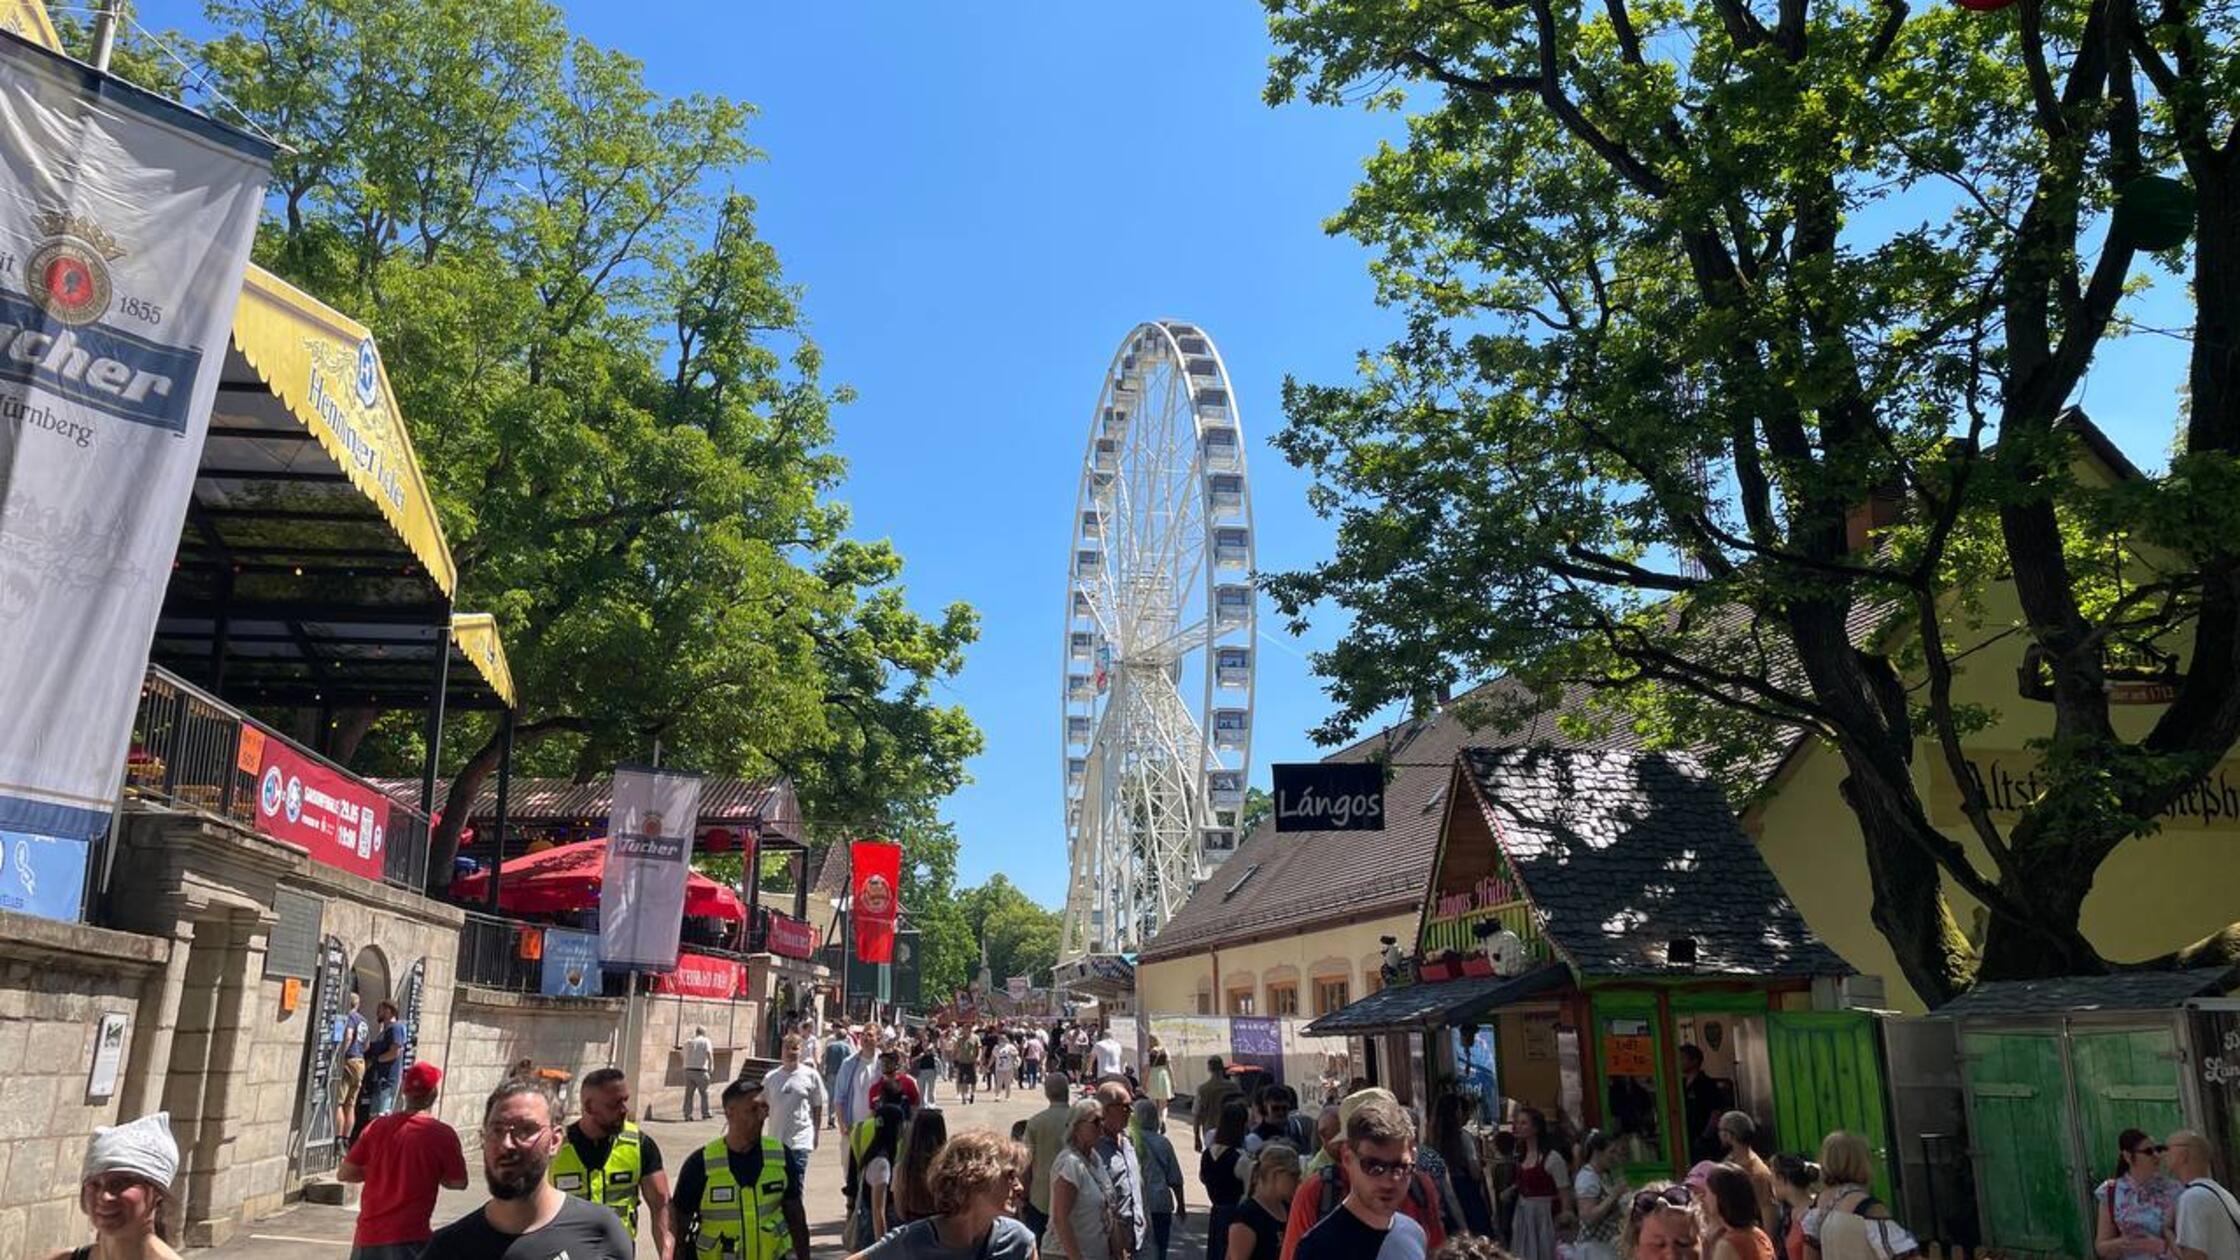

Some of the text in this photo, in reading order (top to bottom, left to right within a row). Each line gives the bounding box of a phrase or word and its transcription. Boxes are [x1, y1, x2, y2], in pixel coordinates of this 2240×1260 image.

[120, 296, 163, 325] 1855
[0, 397, 94, 448] ürnberg
[1279, 786, 1380, 826] Lángos
[618, 838, 679, 857] Tucher
